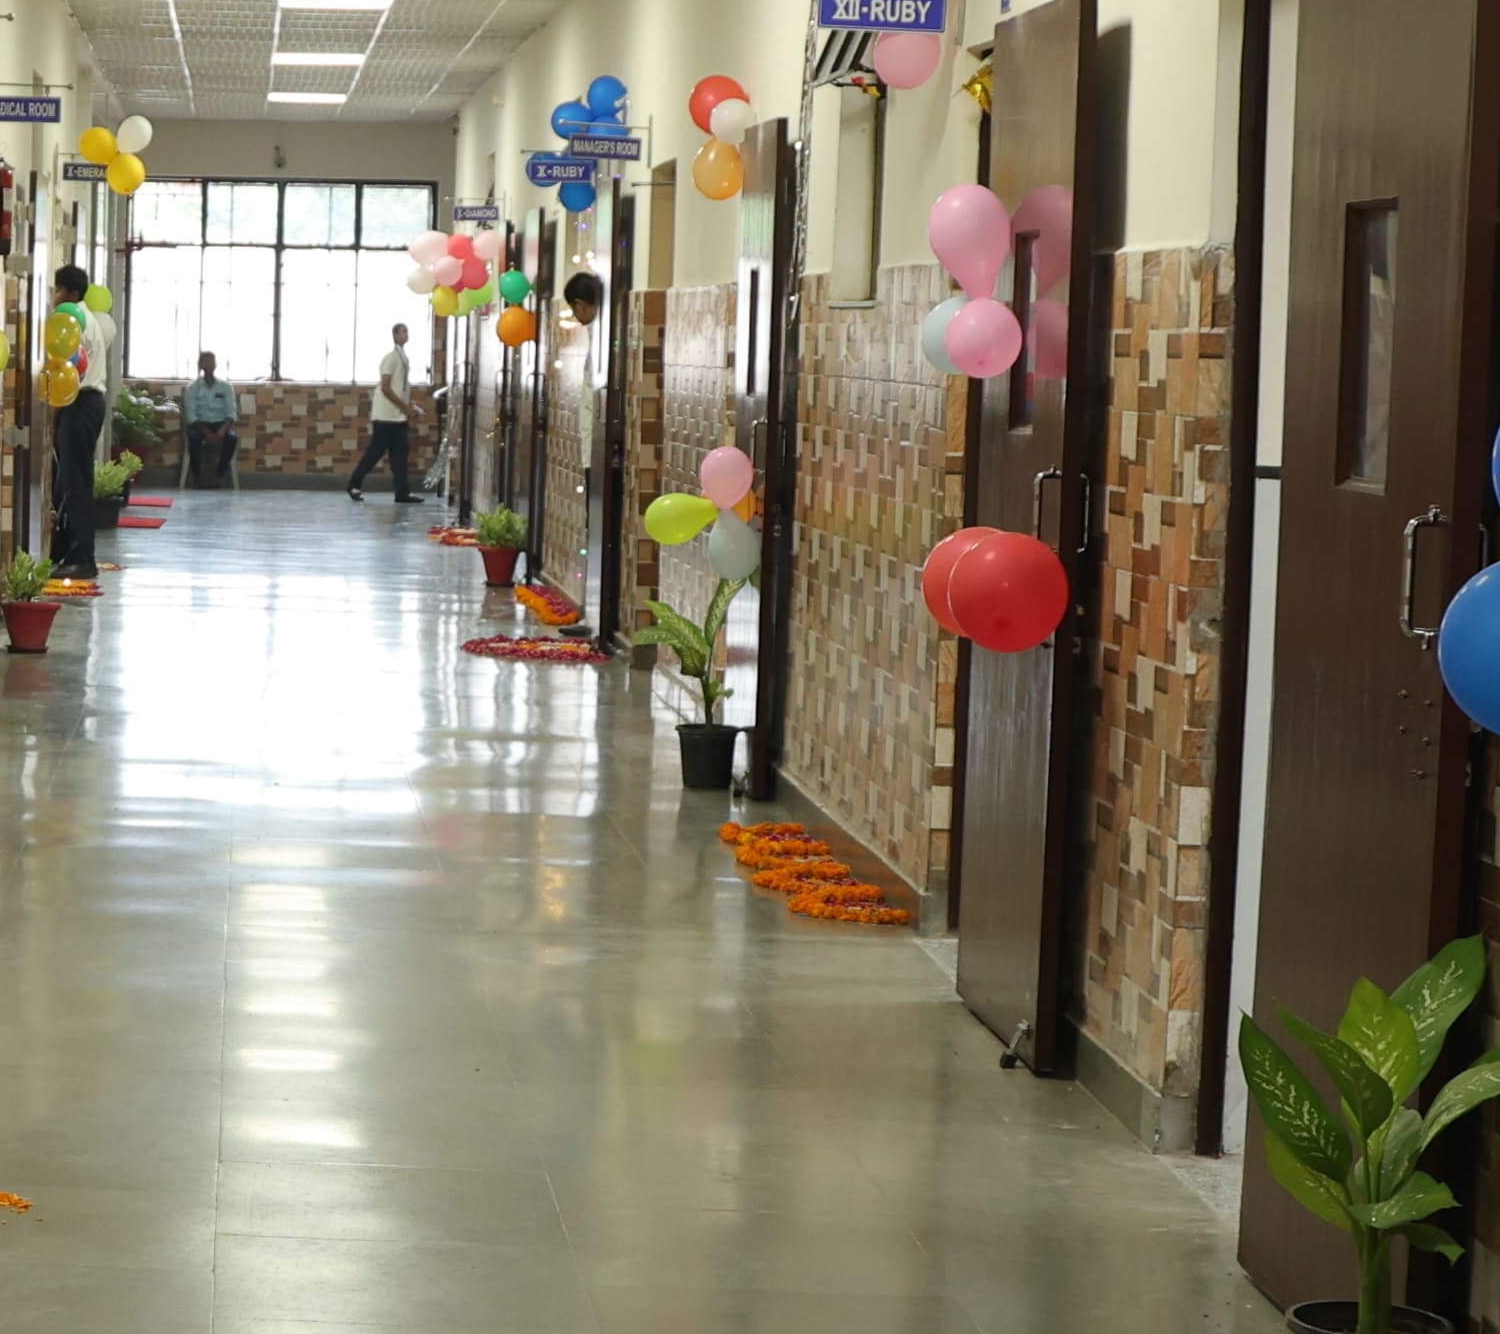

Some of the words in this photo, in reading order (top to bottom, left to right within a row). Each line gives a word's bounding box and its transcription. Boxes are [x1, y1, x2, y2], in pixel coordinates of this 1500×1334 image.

[28, 102, 56, 117] ROOM
[573, 139, 615, 155] MANAGER'S
[617, 141, 639, 156] ROOM
[67, 166, 106, 178] X-EMERA
[536, 165, 585, 178] X-RUBY
